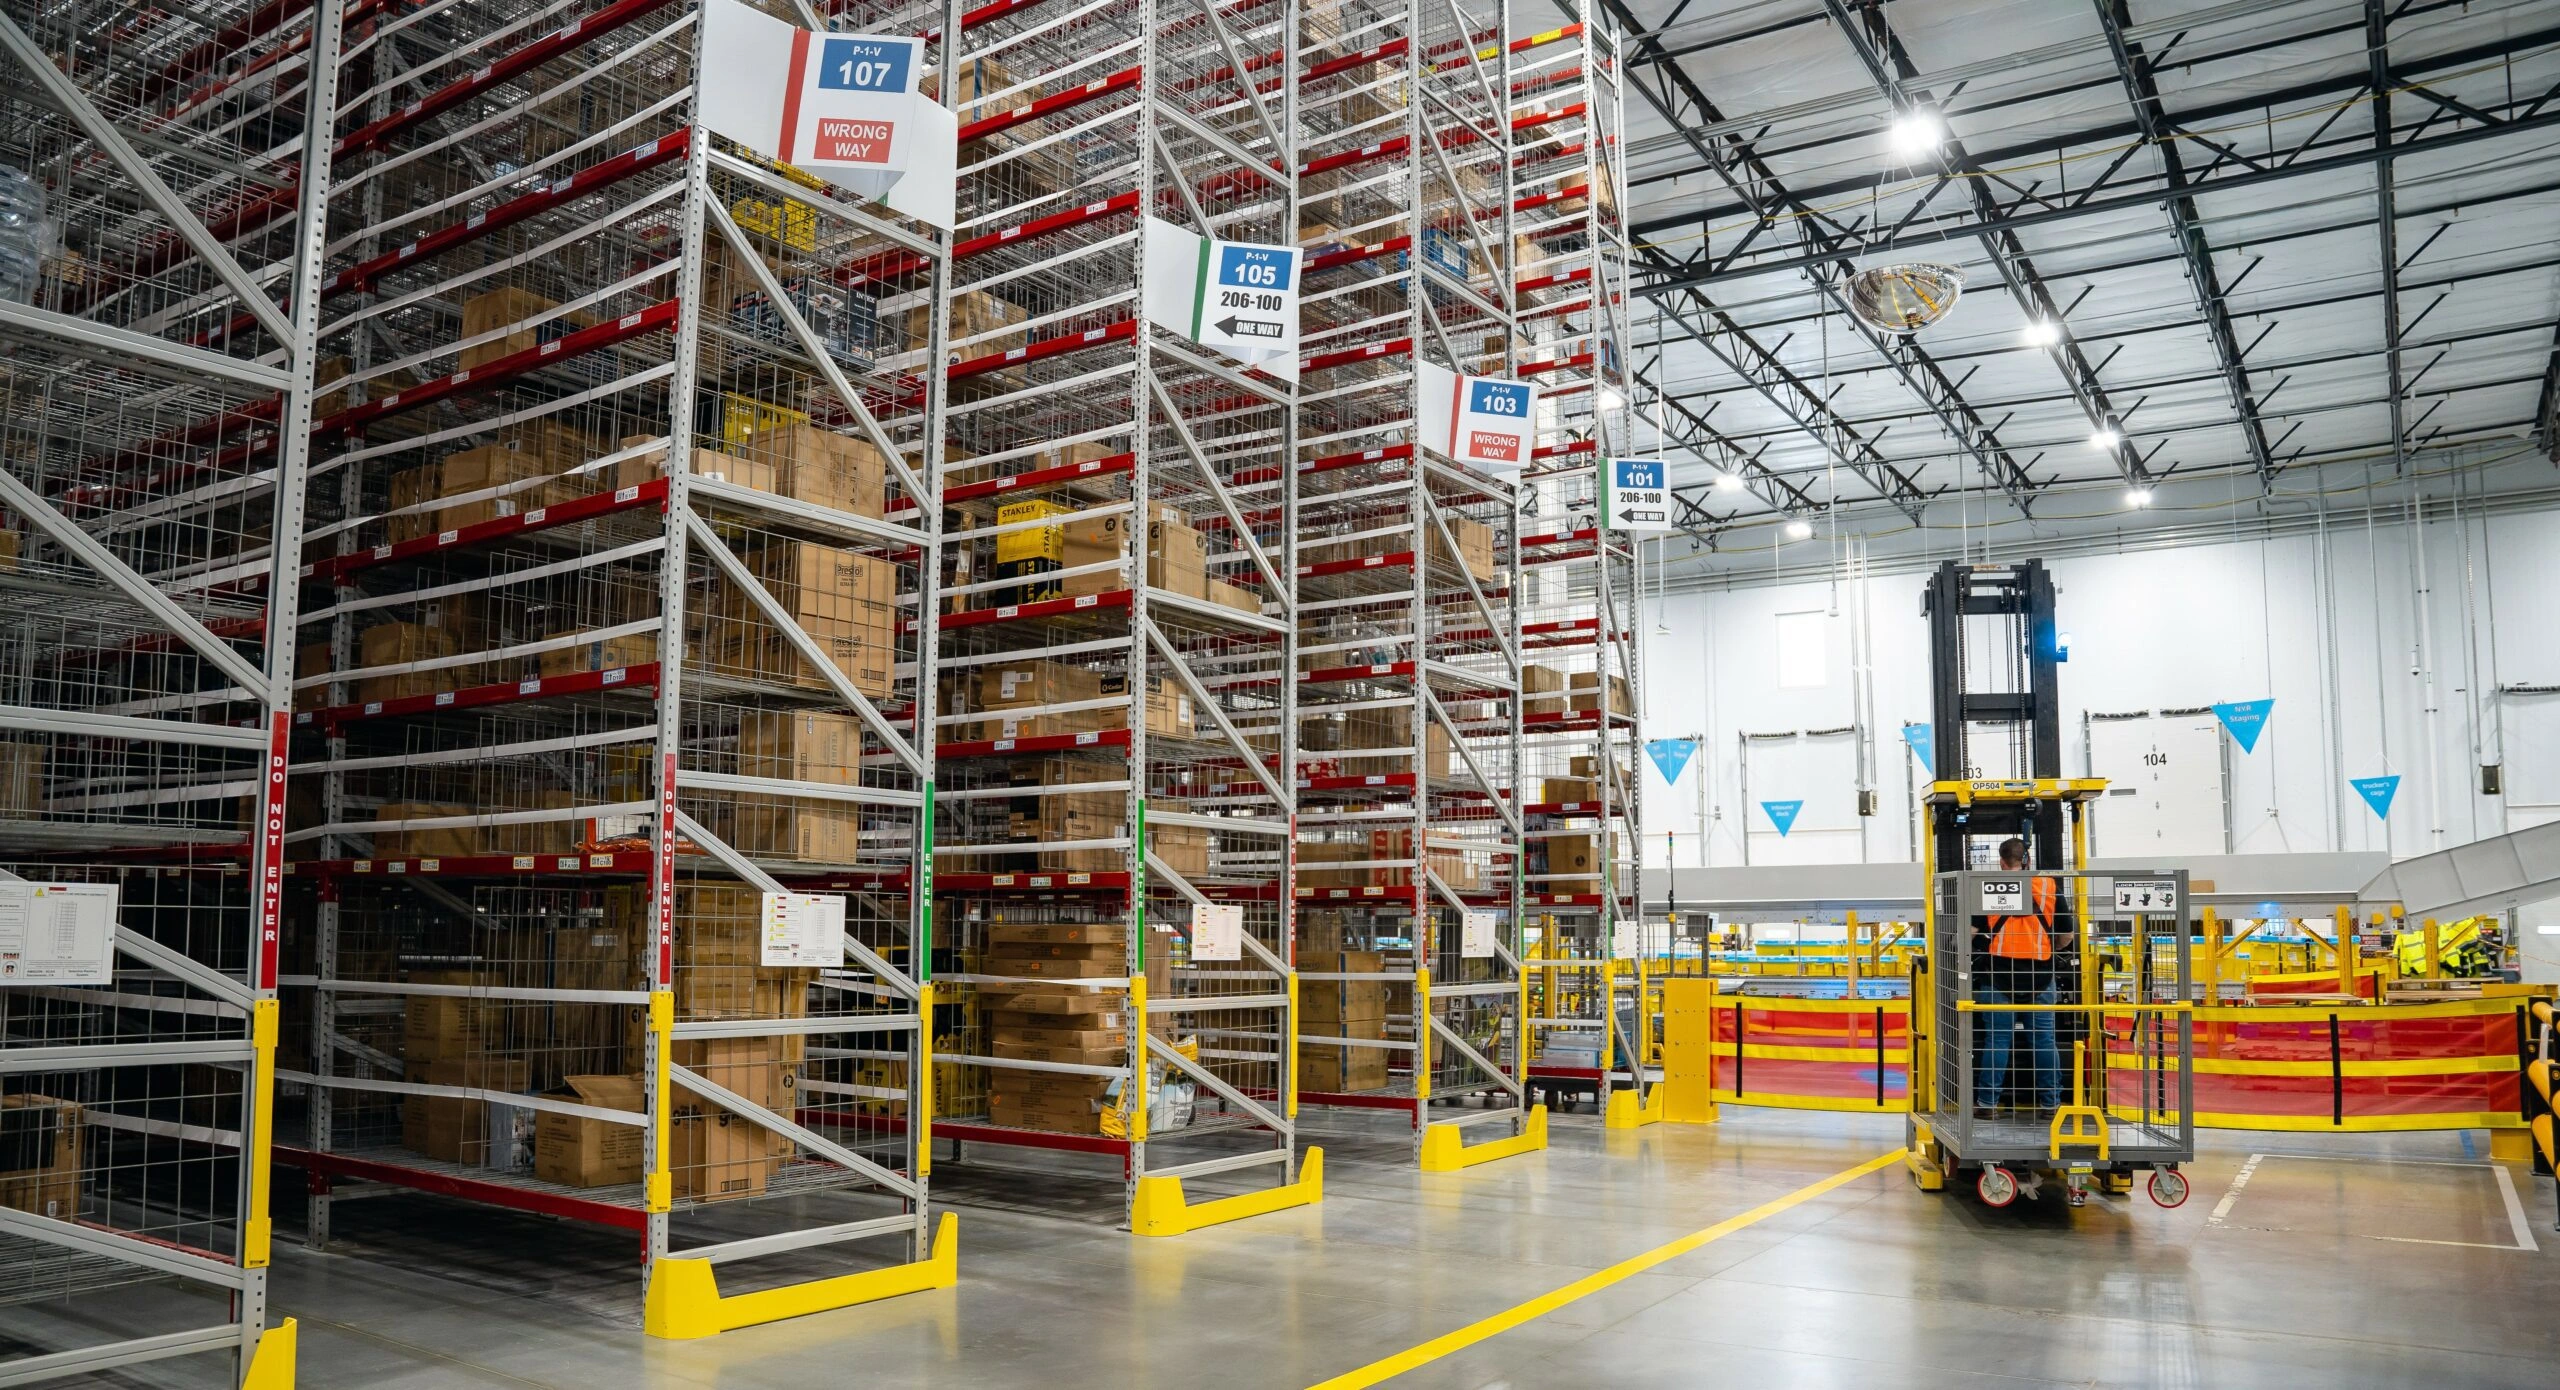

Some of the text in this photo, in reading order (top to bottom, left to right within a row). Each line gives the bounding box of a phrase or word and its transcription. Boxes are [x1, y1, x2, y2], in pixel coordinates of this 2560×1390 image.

[853, 45, 882, 57] P-1-V
[839, 60, 892, 87] 107
[824, 122, 888, 140] WRONG
[835, 142, 872, 158] WAY
[1246, 252, 1269, 261] P-1-V
[1235, 263, 1277, 285] 105
[1220, 291, 1283, 312] 206-100
[1236, 322, 1281, 337] ONE WAY
[1491, 386, 1511, 394] P-1-V
[1483, 395, 1517, 414] 103
[1474, 433, 1517, 447] WRONG
[1482, 446, 1507, 458] WAY
[1626, 471, 1654, 487] 101
[1620, 491, 1662, 504] 206-100
[1002, 503, 1036, 518] STANLEY
[1633, 511, 1664, 521] ONE WAY
[2229, 714, 2260, 723] Staging
[2143, 753, 2167, 766] 104
[1972, 782, 2000, 790] OP504
[264, 756, 284, 942] DO NOT ENTER
[661, 790, 673, 945] DO NOT ENTER
[1984, 883, 2020, 892] 003
